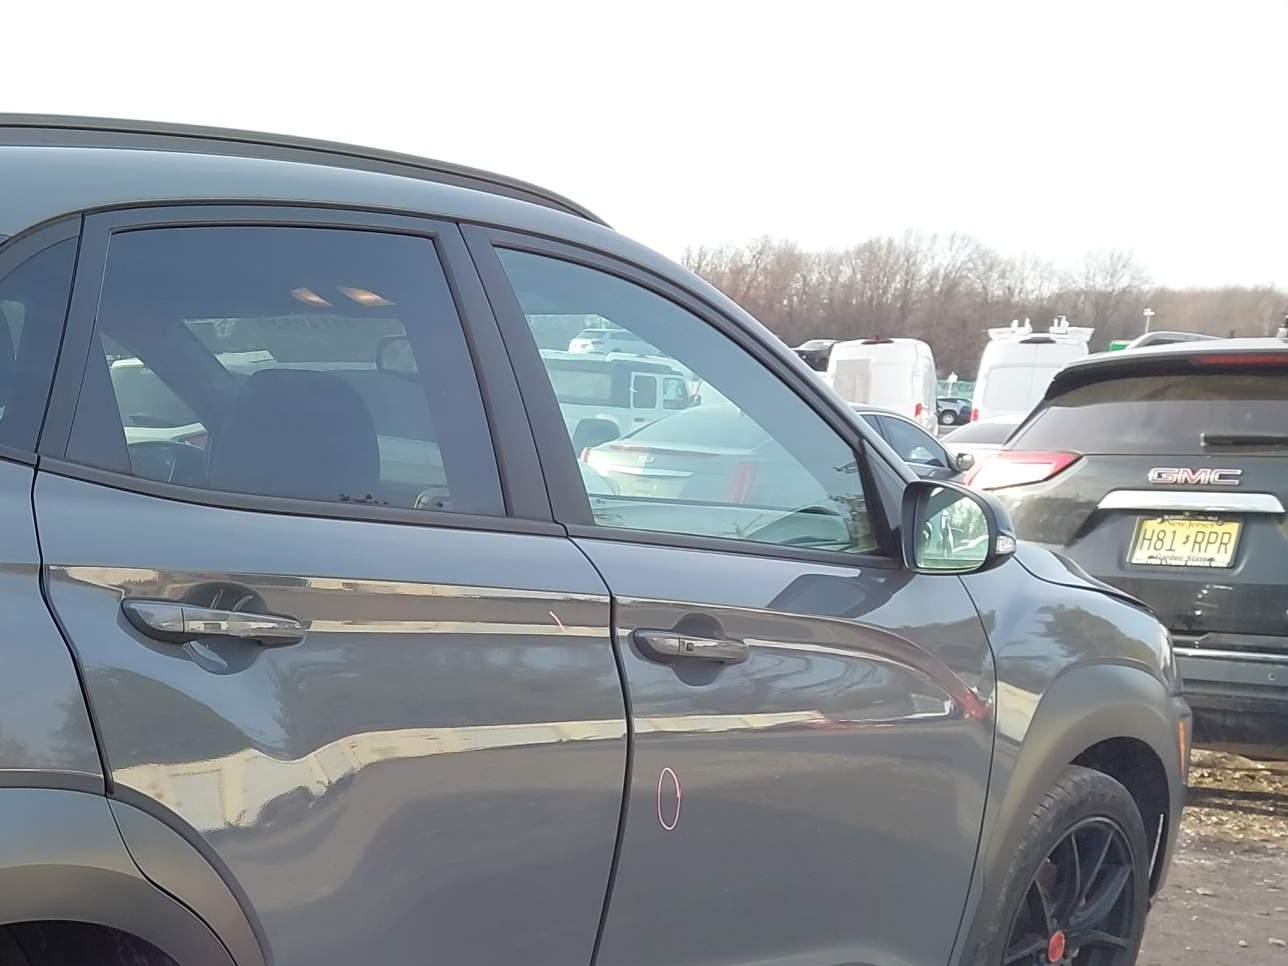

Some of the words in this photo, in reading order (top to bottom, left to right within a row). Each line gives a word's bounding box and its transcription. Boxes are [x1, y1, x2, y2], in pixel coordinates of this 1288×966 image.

[1147, 467, 1242, 485] GMC
[1139, 528, 1177, 552] H81
[1191, 531, 1233, 554] RPR
